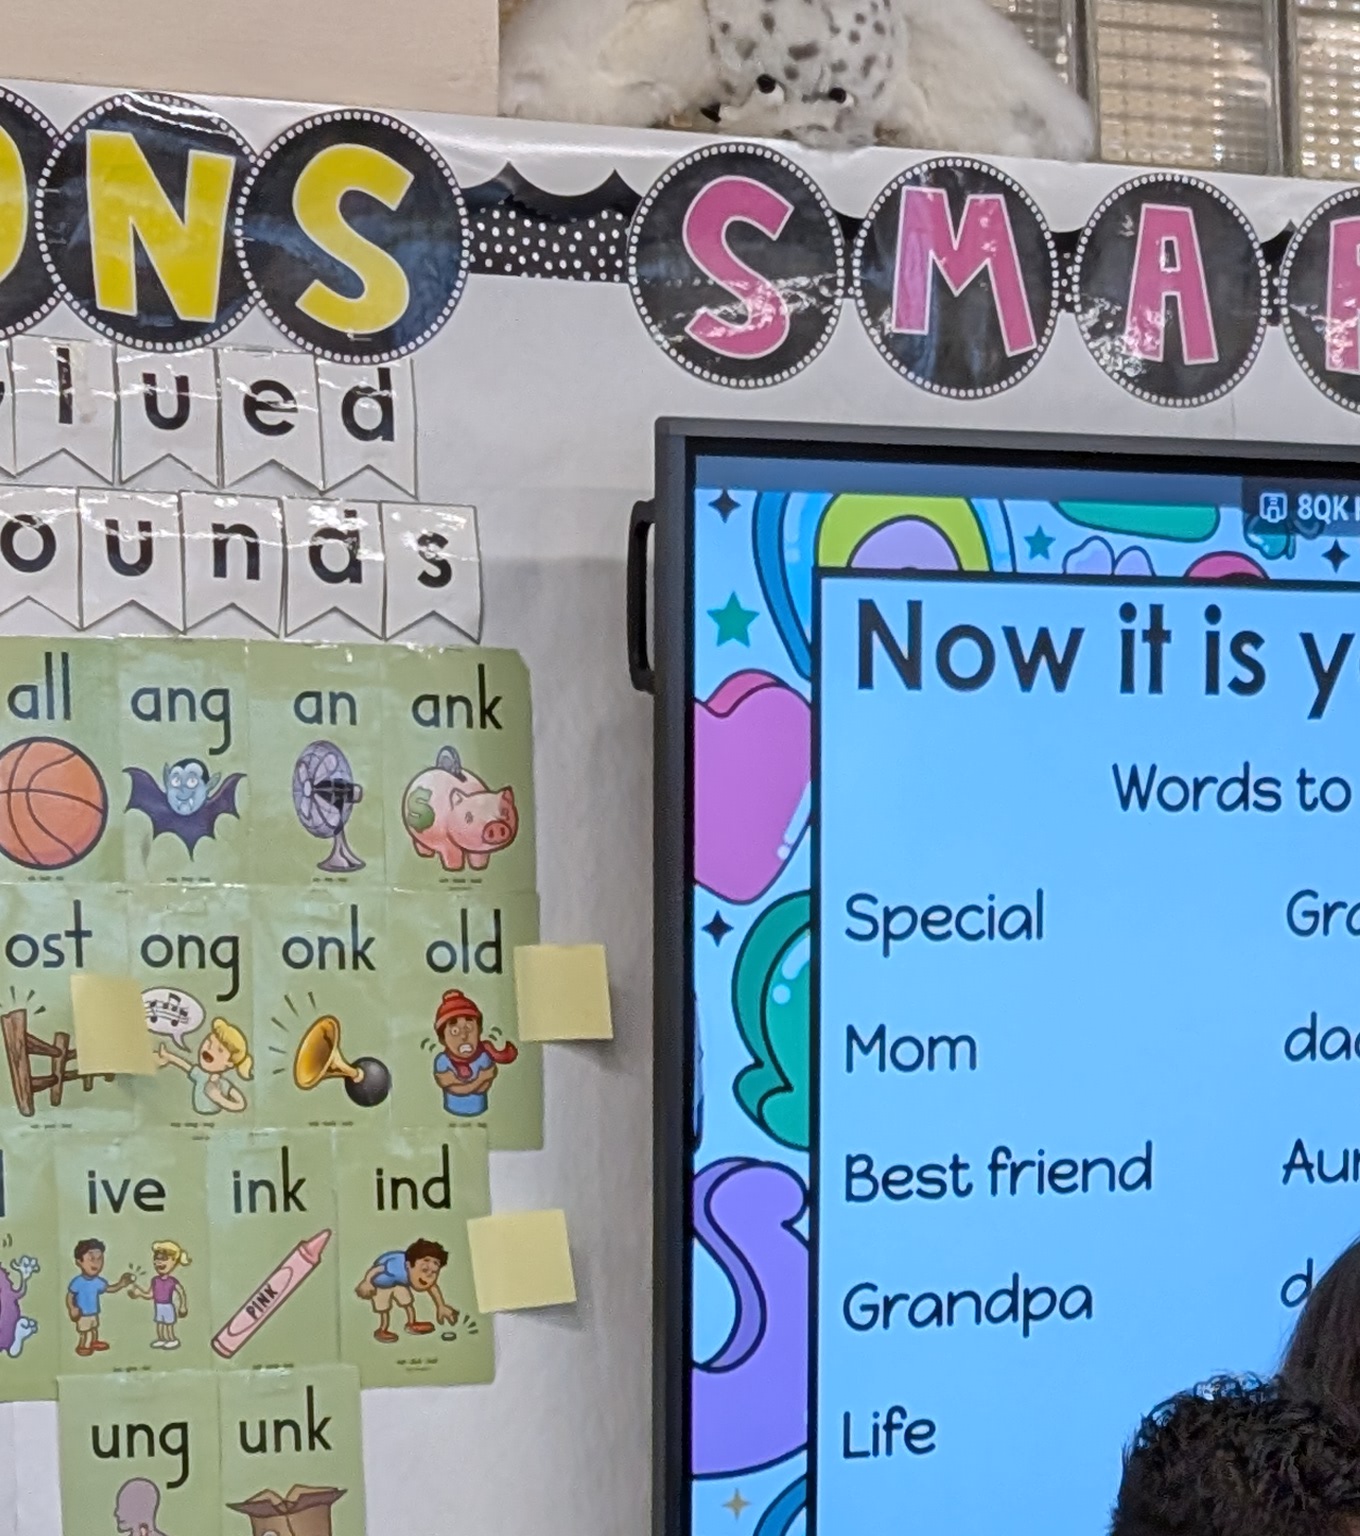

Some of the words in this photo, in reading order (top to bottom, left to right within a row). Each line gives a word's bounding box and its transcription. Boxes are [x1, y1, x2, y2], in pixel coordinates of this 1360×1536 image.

[0, 127, 415, 334] NS
[0, 347, 395, 442] lued
[1297, 495, 1349, 522] 8QK
[2, 509, 453, 588] ounds
[856, 598, 1085, 693] Now
[1119, 602, 1172, 696] it
[1204, 604, 1266, 696] is
[8, 652, 71, 721] all
[131, 684, 231, 755] ang
[294, 689, 357, 726] an
[411, 664, 502, 730] ank
[1111, 762, 1282, 813] Words
[1299, 767, 1352, 812] to
[5, 900, 92, 969] ost
[281, 904, 375, 971] onk
[425, 908, 501, 975] old
[844, 888, 1044, 958] Special
[140, 932, 239, 1002] ong
[845, 1024, 977, 1073] Mom
[87, 1170, 166, 1214] ive
[233, 1146, 307, 1214] ink
[374, 1143, 452, 1211] ind
[845, 1152, 973, 1203] Best
[988, 1140, 1153, 1198] friend
[245, 1282, 280, 1320] PINK
[842, 1272, 1093, 1339] Grandpa
[239, 1385, 332, 1453] unk
[842, 1405, 936, 1459] Life
[90, 1418, 189, 1490] ung
